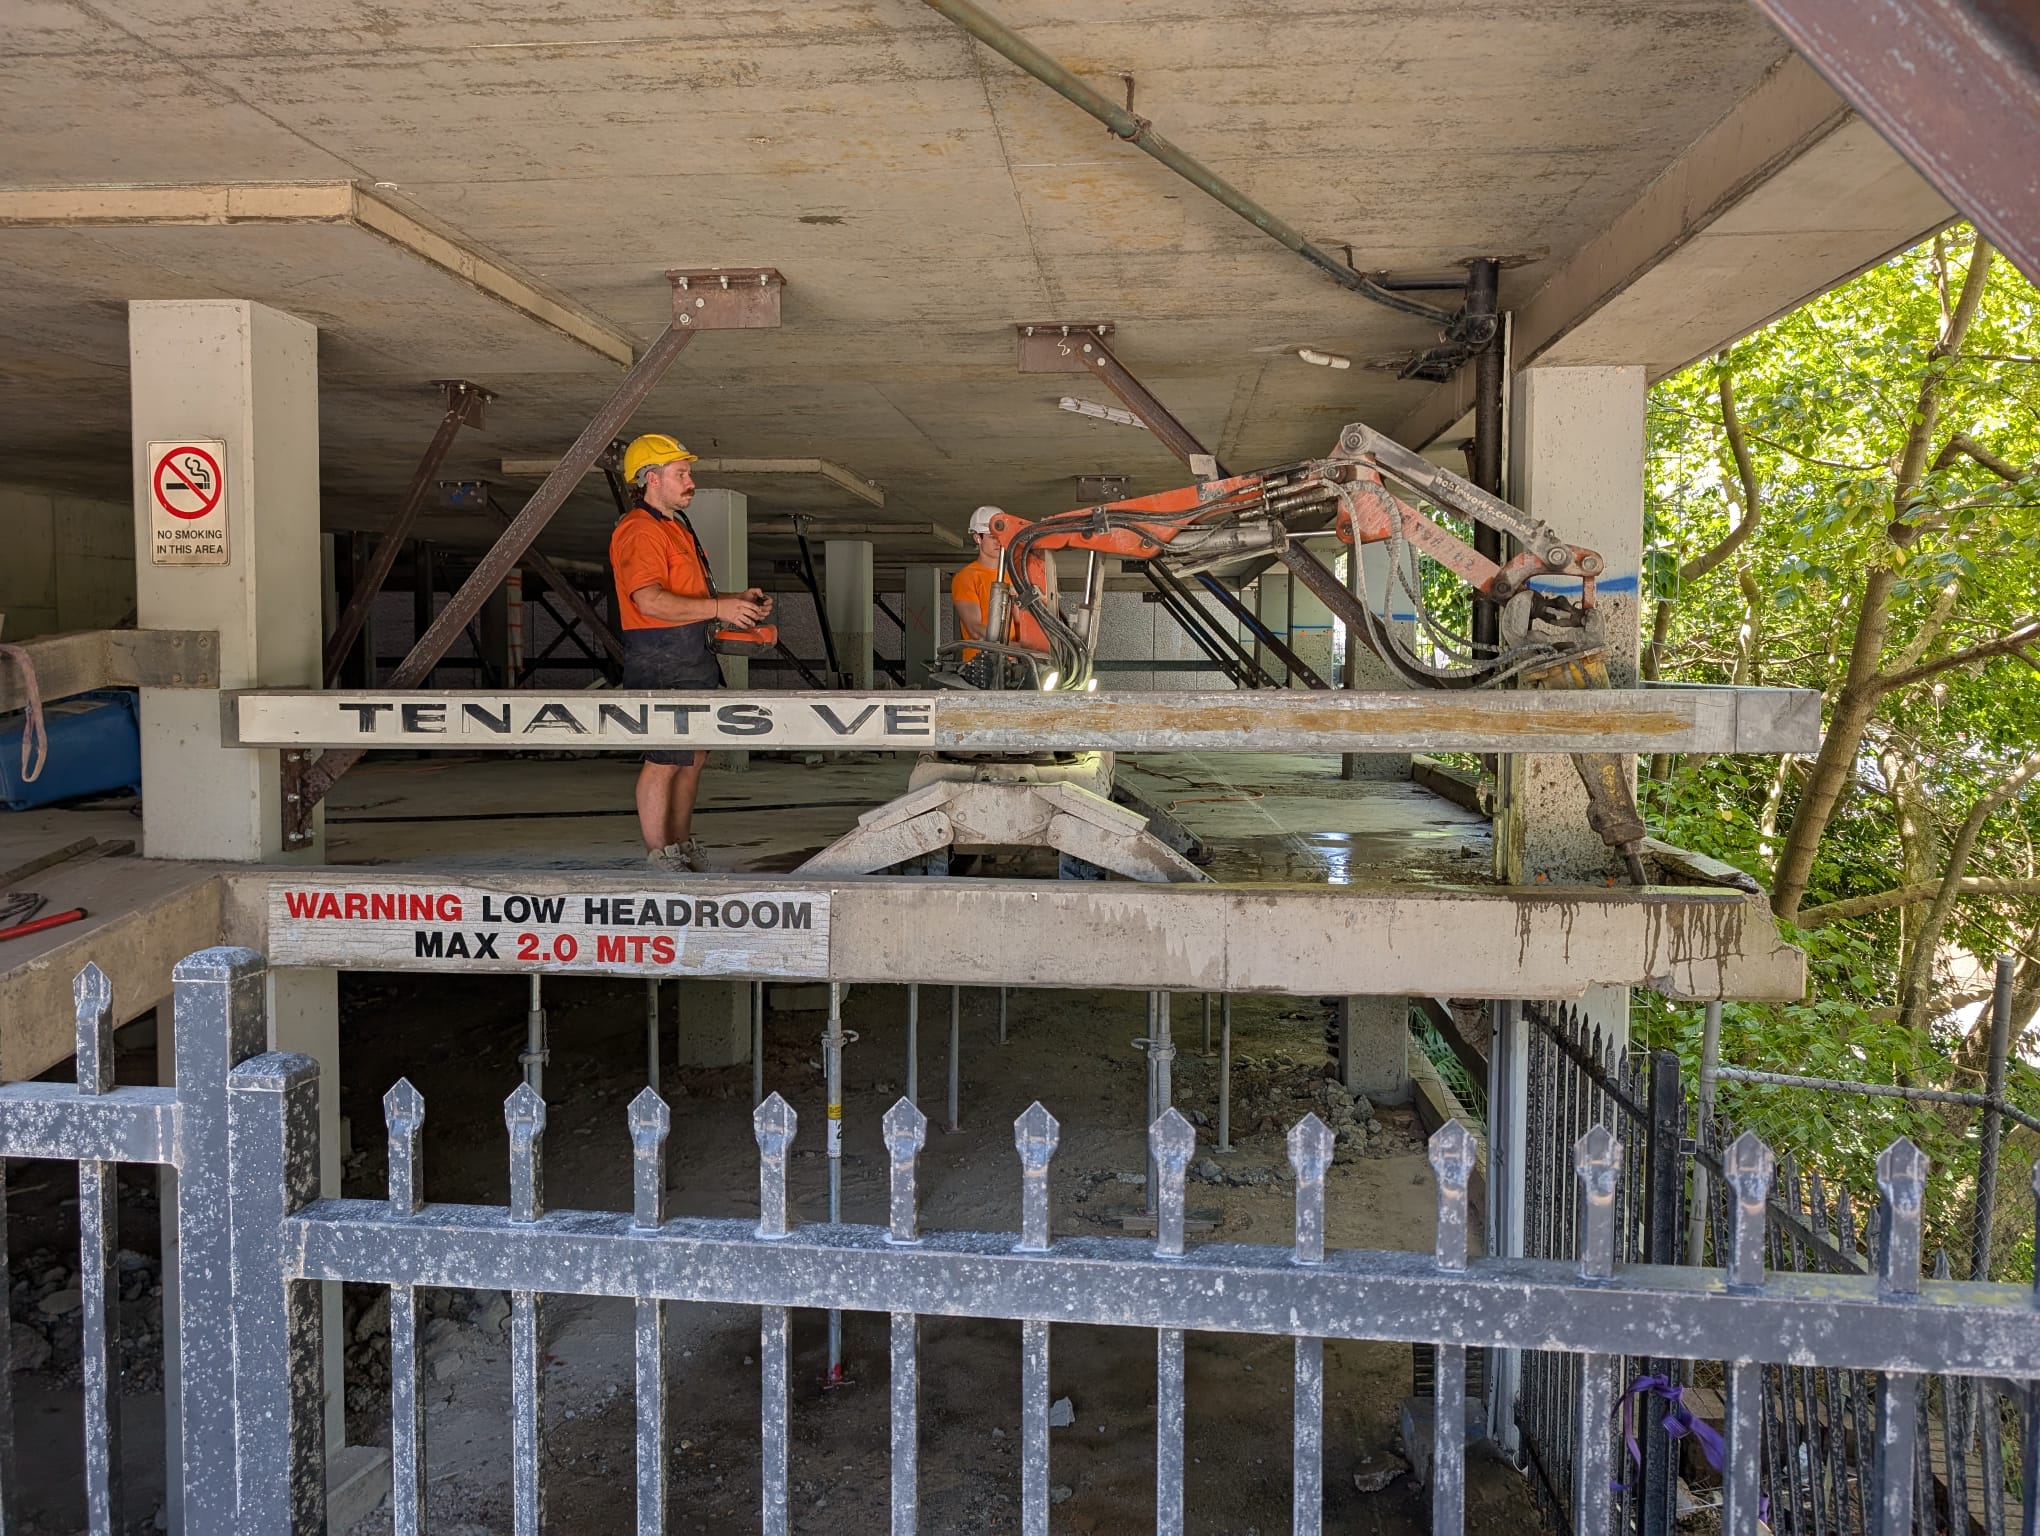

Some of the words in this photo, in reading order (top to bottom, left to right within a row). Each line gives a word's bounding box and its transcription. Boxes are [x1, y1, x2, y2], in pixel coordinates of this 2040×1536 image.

[157, 545, 166, 553] IN
[169, 545, 192, 553] THIS
[195, 545, 223, 553] AREA
[158, 530, 172, 539] NO
[175, 530, 222, 539] SMOKING
[339, 703, 774, 735] TENANTS
[811, 704, 932, 735] VE
[285, 891, 463, 922] WARNING
[482, 896, 565, 924] LOW
[584, 898, 812, 929] HEADROOM
[415, 932, 499, 960] MAX
[517, 934, 578, 963] 2.0
[598, 936, 676, 965] MTS
